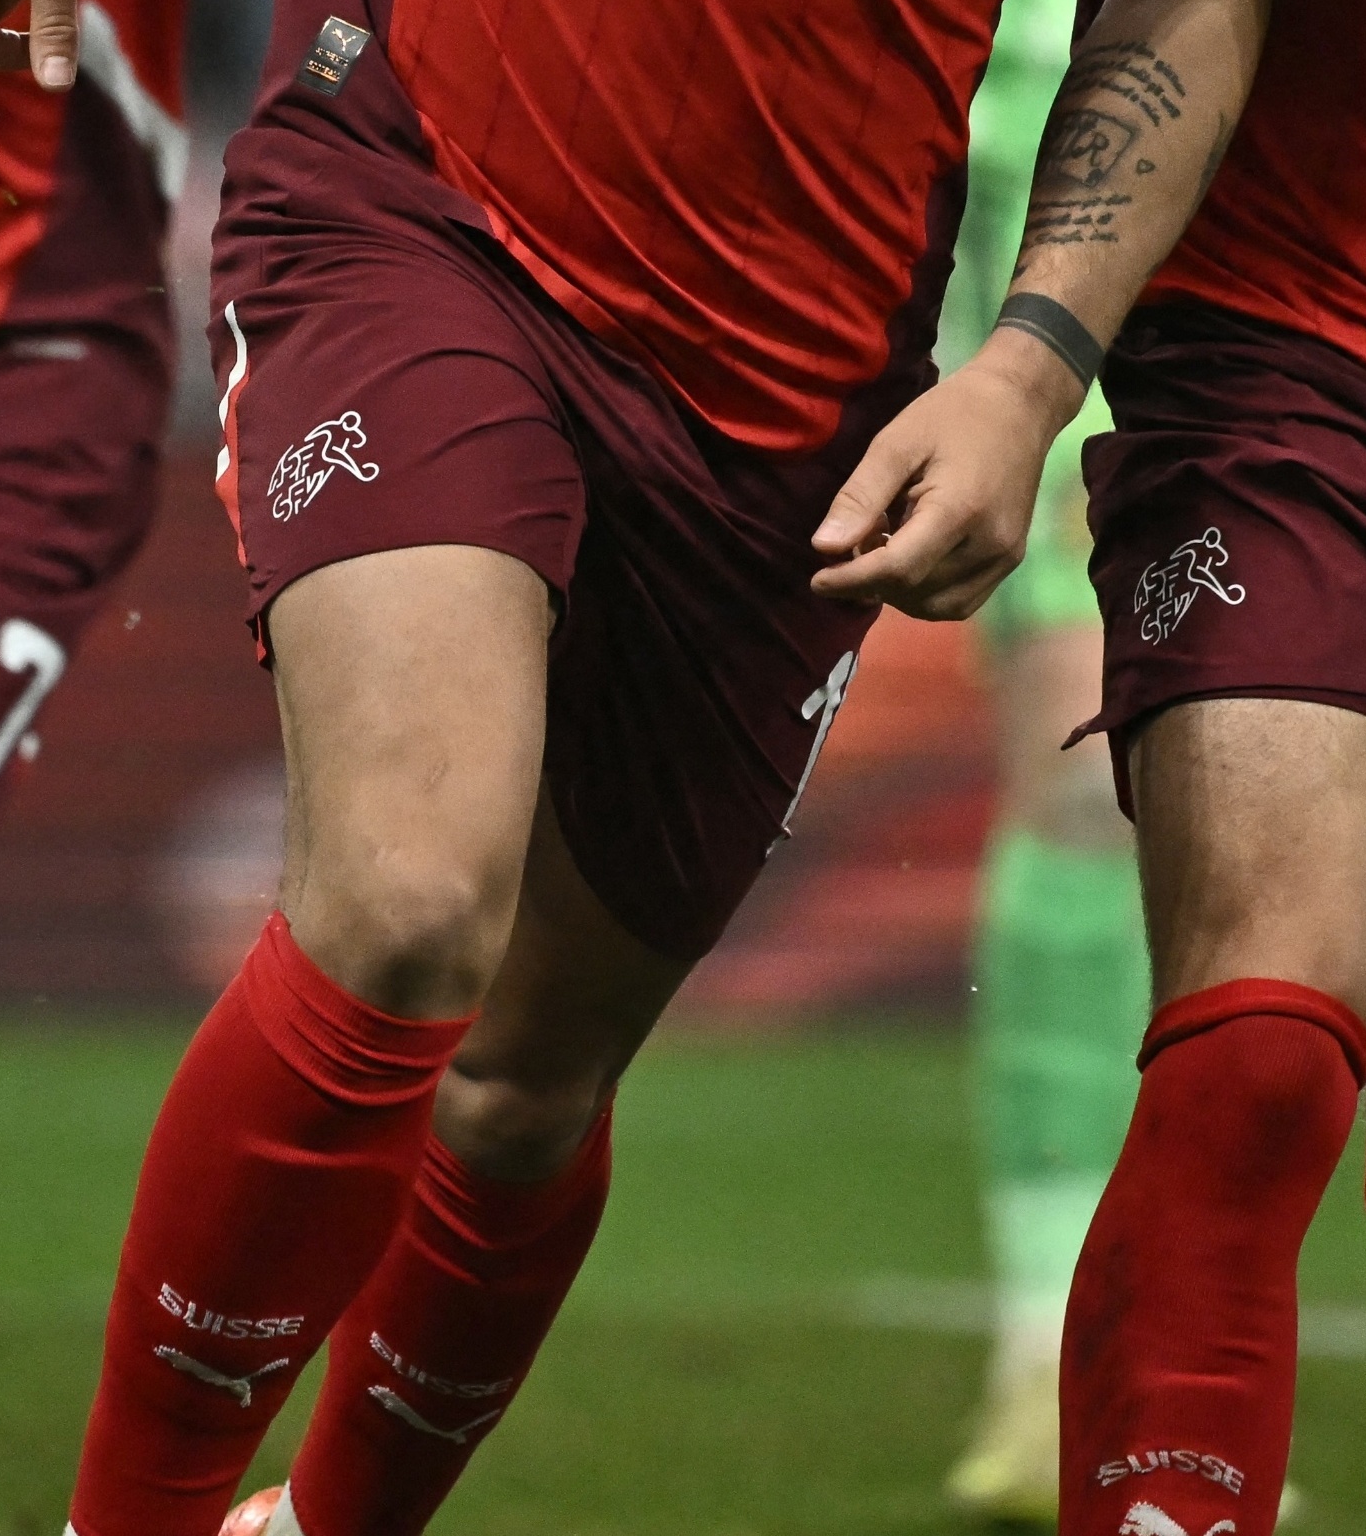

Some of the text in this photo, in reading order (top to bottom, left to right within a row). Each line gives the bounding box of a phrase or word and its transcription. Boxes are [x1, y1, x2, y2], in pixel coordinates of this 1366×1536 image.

[157, 1282, 305, 1339] SUISSE
[370, 1330, 513, 1398] SUISSE
[1097, 1450, 1246, 1496] SUISSE
